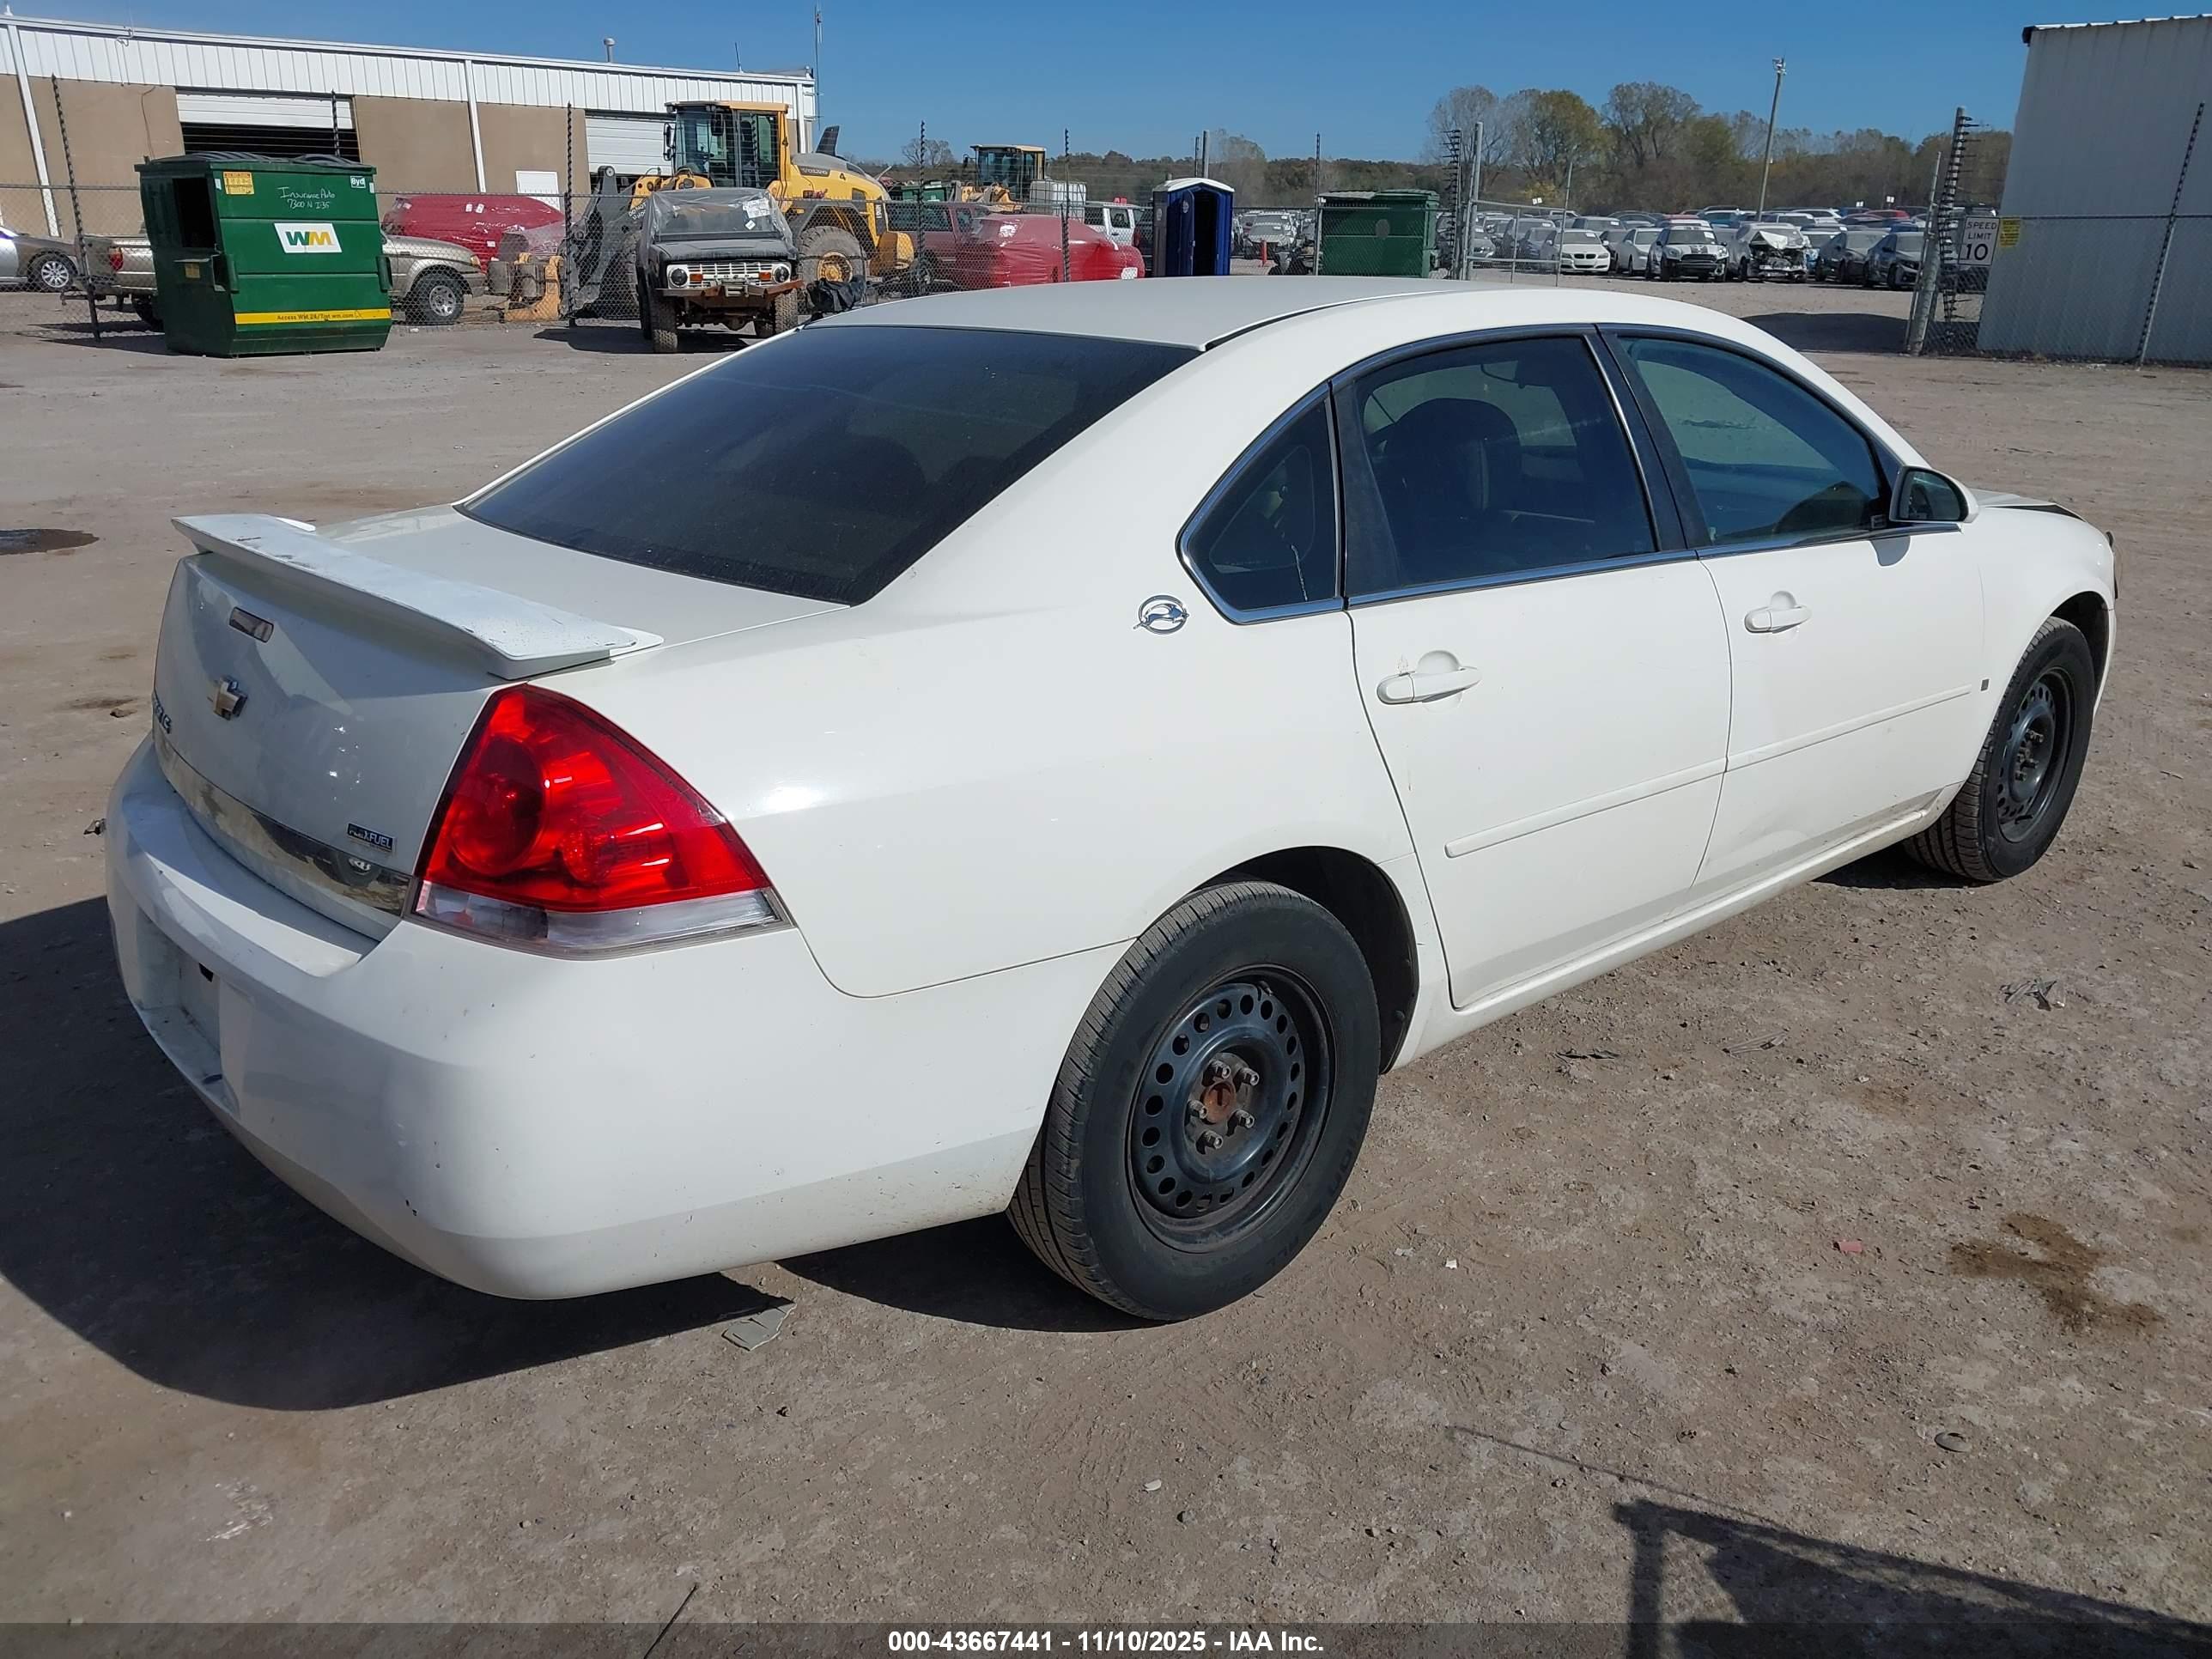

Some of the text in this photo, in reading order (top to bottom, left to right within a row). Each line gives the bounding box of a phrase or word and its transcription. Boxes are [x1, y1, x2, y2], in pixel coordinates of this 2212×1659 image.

[320, 187, 336, 198] Auto
[1966, 222, 1997, 230] SPEED
[285, 231, 332, 246] WM
[1966, 243, 1989, 261] 10
